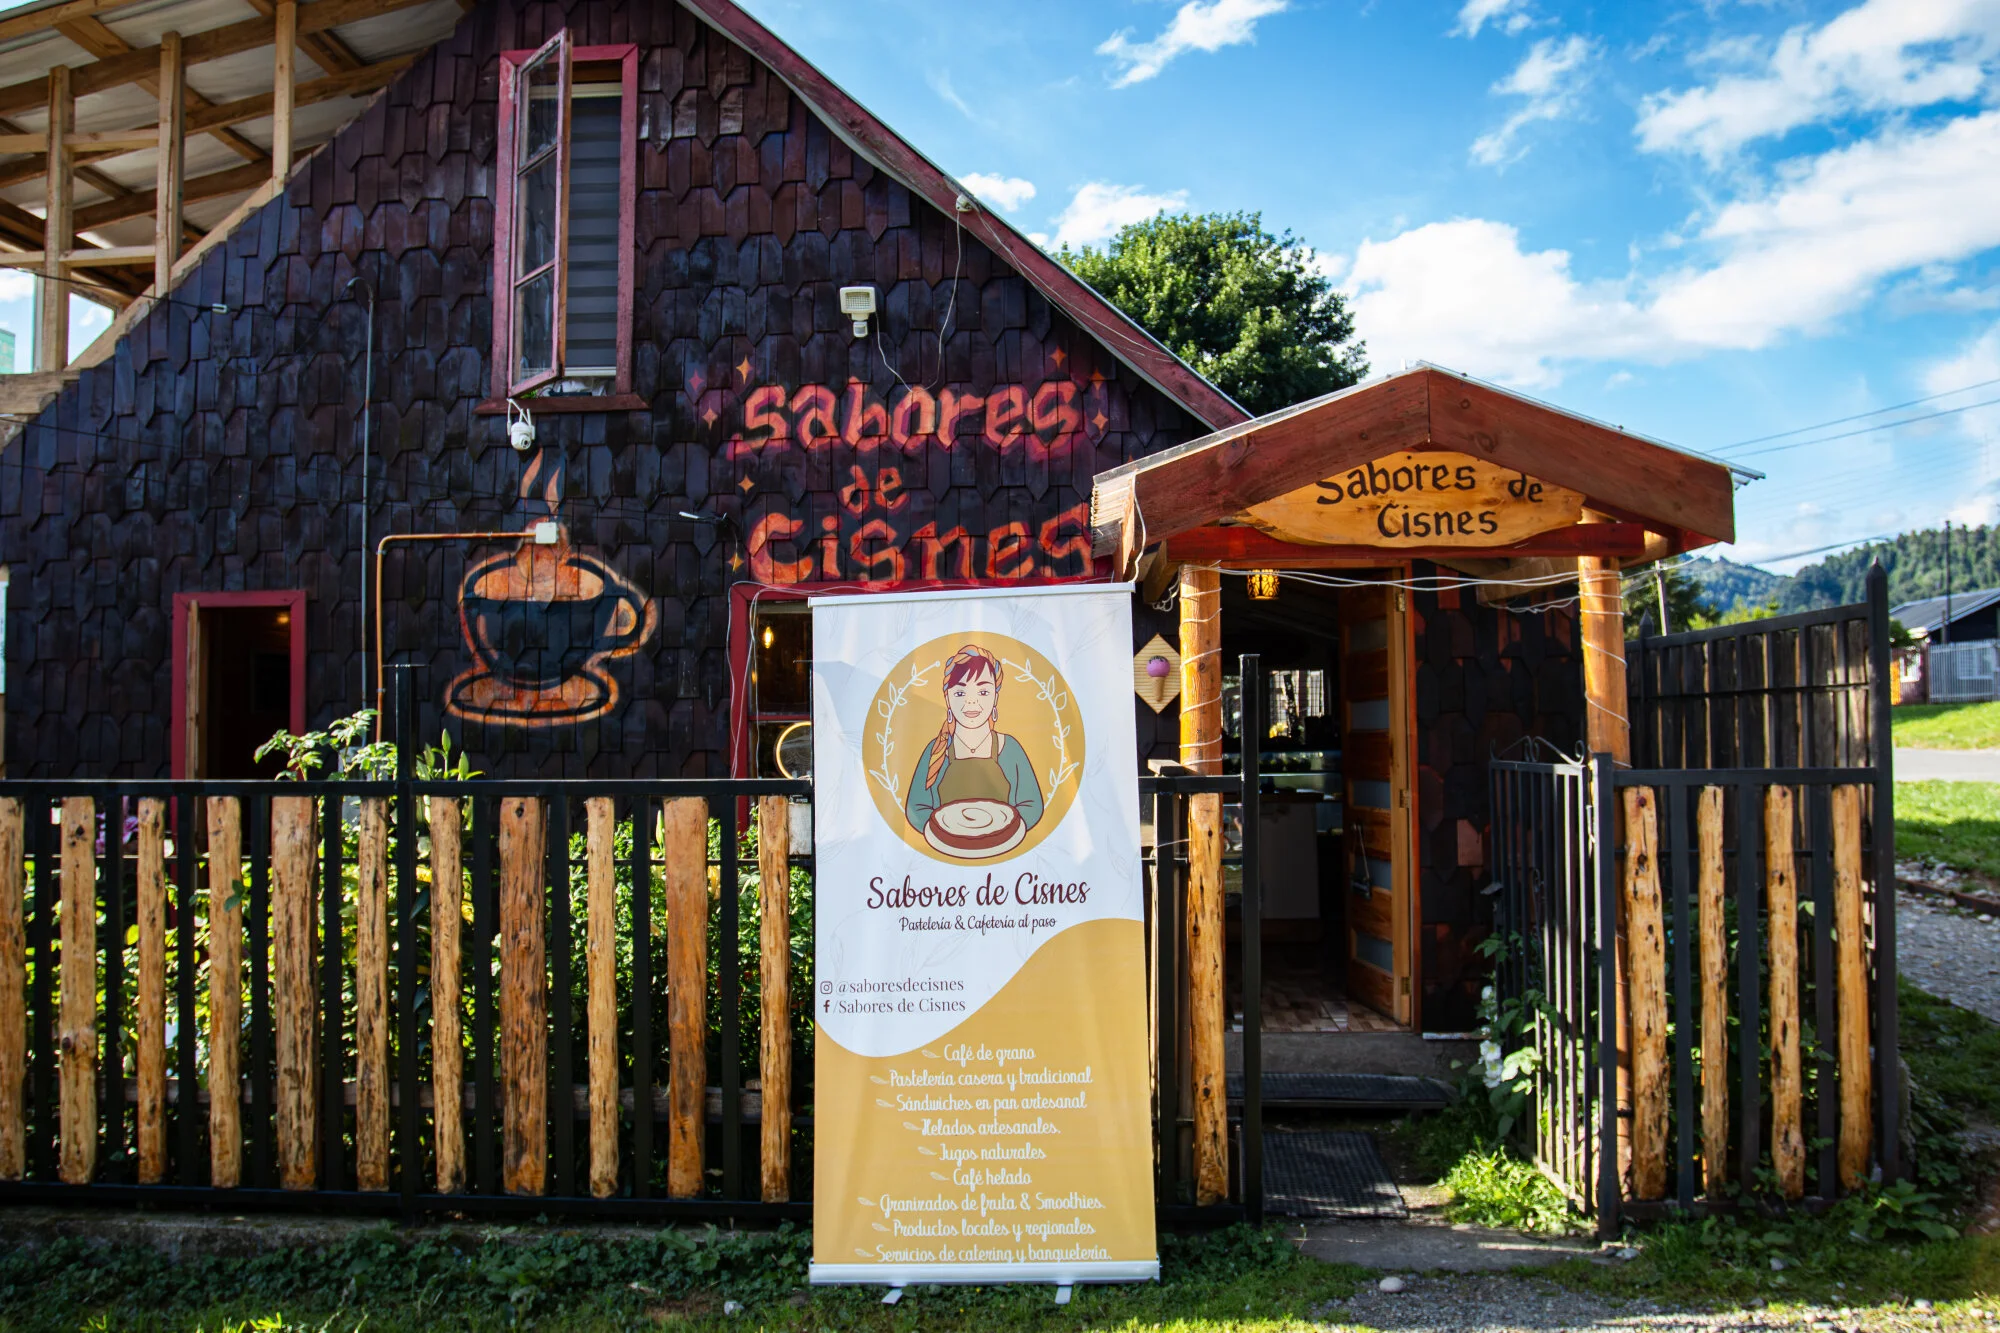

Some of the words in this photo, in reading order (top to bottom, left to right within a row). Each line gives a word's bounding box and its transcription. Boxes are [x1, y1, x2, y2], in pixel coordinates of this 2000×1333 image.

[840, 465, 910, 514] de
[1315, 461, 1477, 504] Sabores
[1507, 474, 1544, 503] de
[1377, 503, 1499, 538] Cisnes
[867, 873, 970, 909] Sabores
[976, 872, 1009, 906] de
[1014, 870, 1091, 905] Cisnes
[899, 915, 952, 932] Pastelería
[954, 914, 966, 930] &
[967, 915, 1015, 936] Cafetería
[1018, 914, 1030, 928] al
[1031, 917, 1057, 934] paso
[836, 977, 964, 997] @saboresdecisnes
[897, 997, 915, 1013] de
[918, 998, 966, 1012] Cisnes
[943, 1043, 975, 1068] Café
[977, 1046, 994, 1061] de
[996, 1047, 1036, 1066] grano
[889, 1069, 955, 1087] Pastelería
[958, 1072, 1004, 1086] casera
[1007, 1073, 1017, 1092] y
[1019, 1066, 1093, 1085] tradicional
[896, 1094, 973, 1112] Sándwiches
[975, 1098, 991, 1110] en
[993, 1096, 1019, 1116] pan
[1021, 1091, 1087, 1109] artesanal
[921, 1117, 976, 1136] Helados
[978, 1116, 1061, 1135] artesanales.
[938, 1143, 978, 1167] Jugos
[981, 1141, 1047, 1160] naturales
[953, 1167, 983, 1192] Café
[985, 1167, 1032, 1185] helado
[879, 1193, 959, 1219] Granizados
[961, 1193, 978, 1211] de
[980, 1192, 1017, 1218] fruta
[1020, 1192, 1031, 1211] &
[893, 1218, 959, 1237] Productos
[961, 1218, 1010, 1236] locales
[1012, 1223, 1023, 1242] y
[1025, 1217, 1096, 1242] regionales
[876, 1244, 936, 1262] Servicios
[938, 1244, 957, 1261] de
[958, 1244, 1013, 1263] catering
[1015, 1248, 1026, 1263] y
